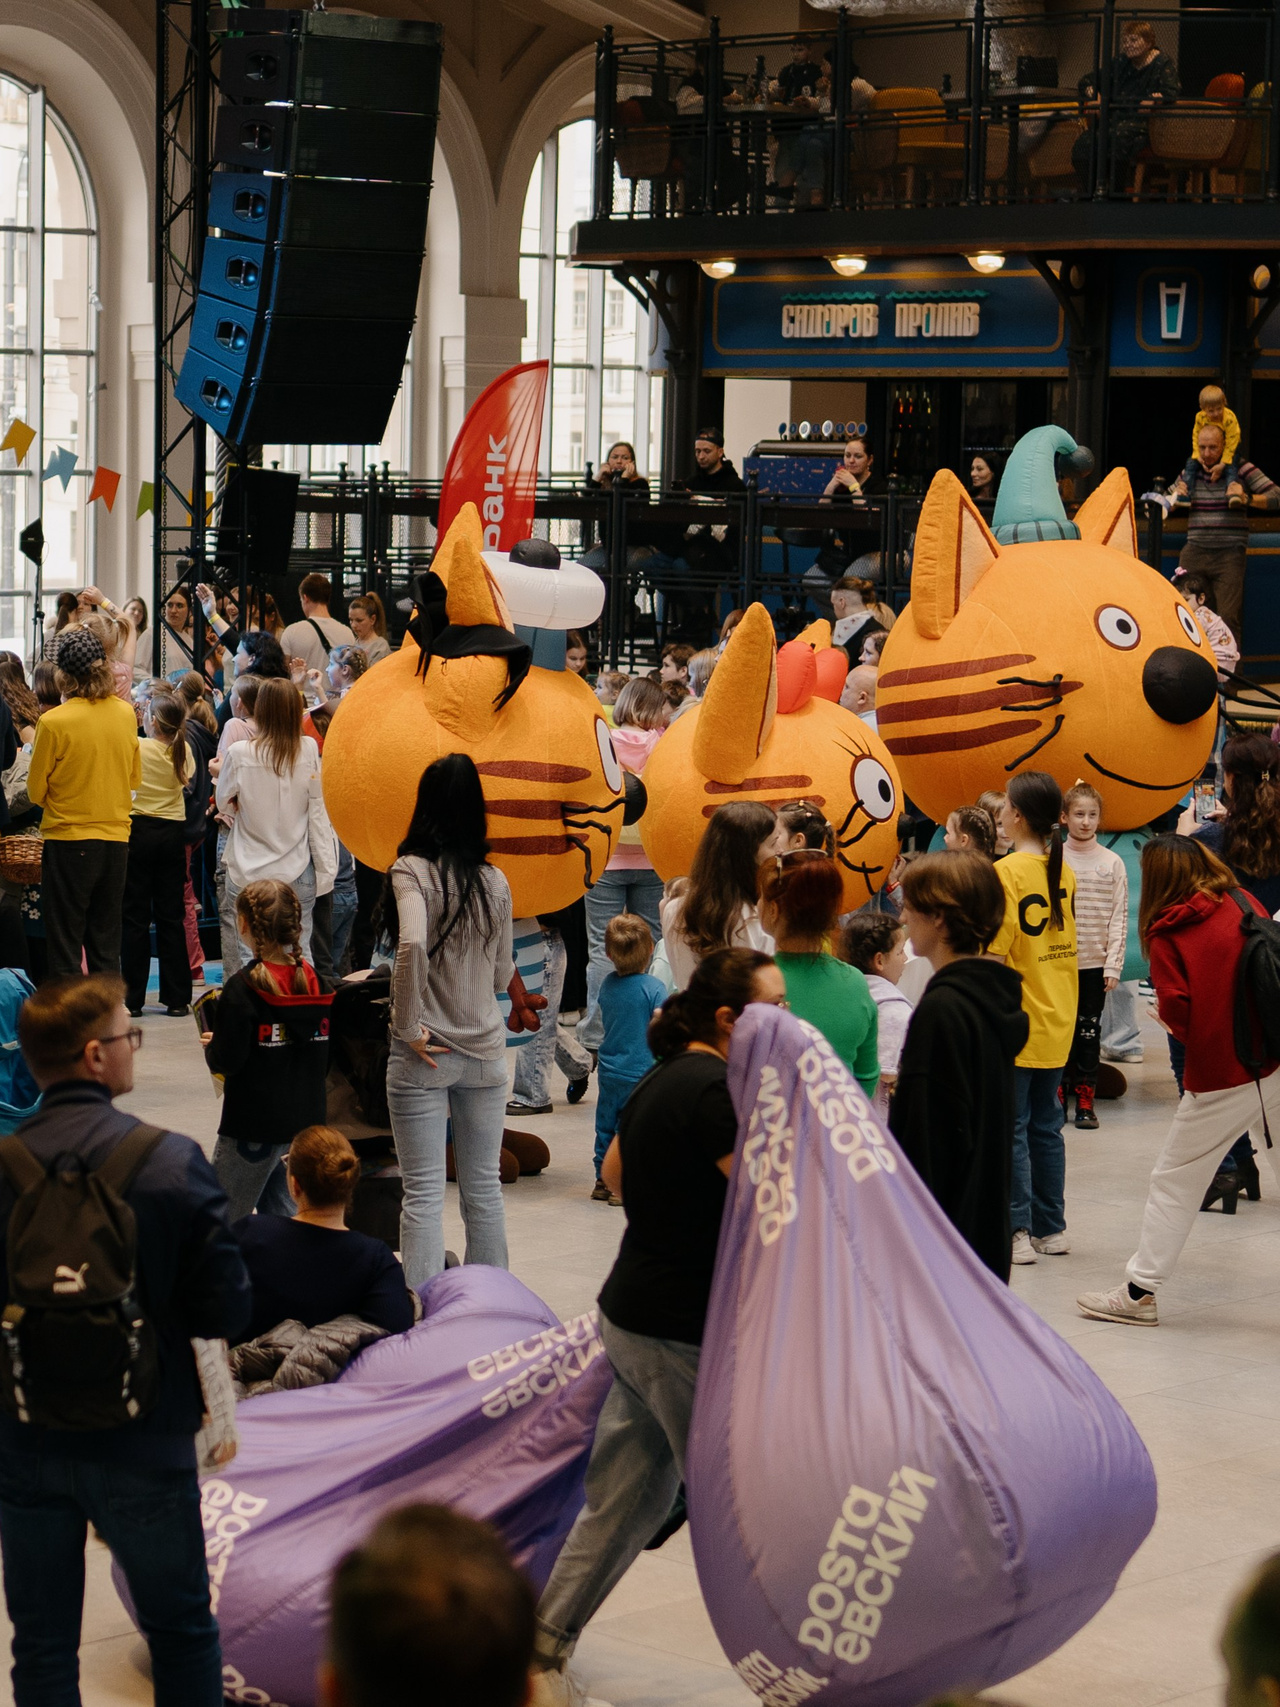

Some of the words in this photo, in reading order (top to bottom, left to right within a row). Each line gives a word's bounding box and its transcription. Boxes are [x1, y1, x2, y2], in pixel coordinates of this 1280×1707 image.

[782, 304, 879, 338] СИДОРОВ
[895, 303, 980, 337] ПРОЛИВ
[743, 1107, 781, 1247] DOST
